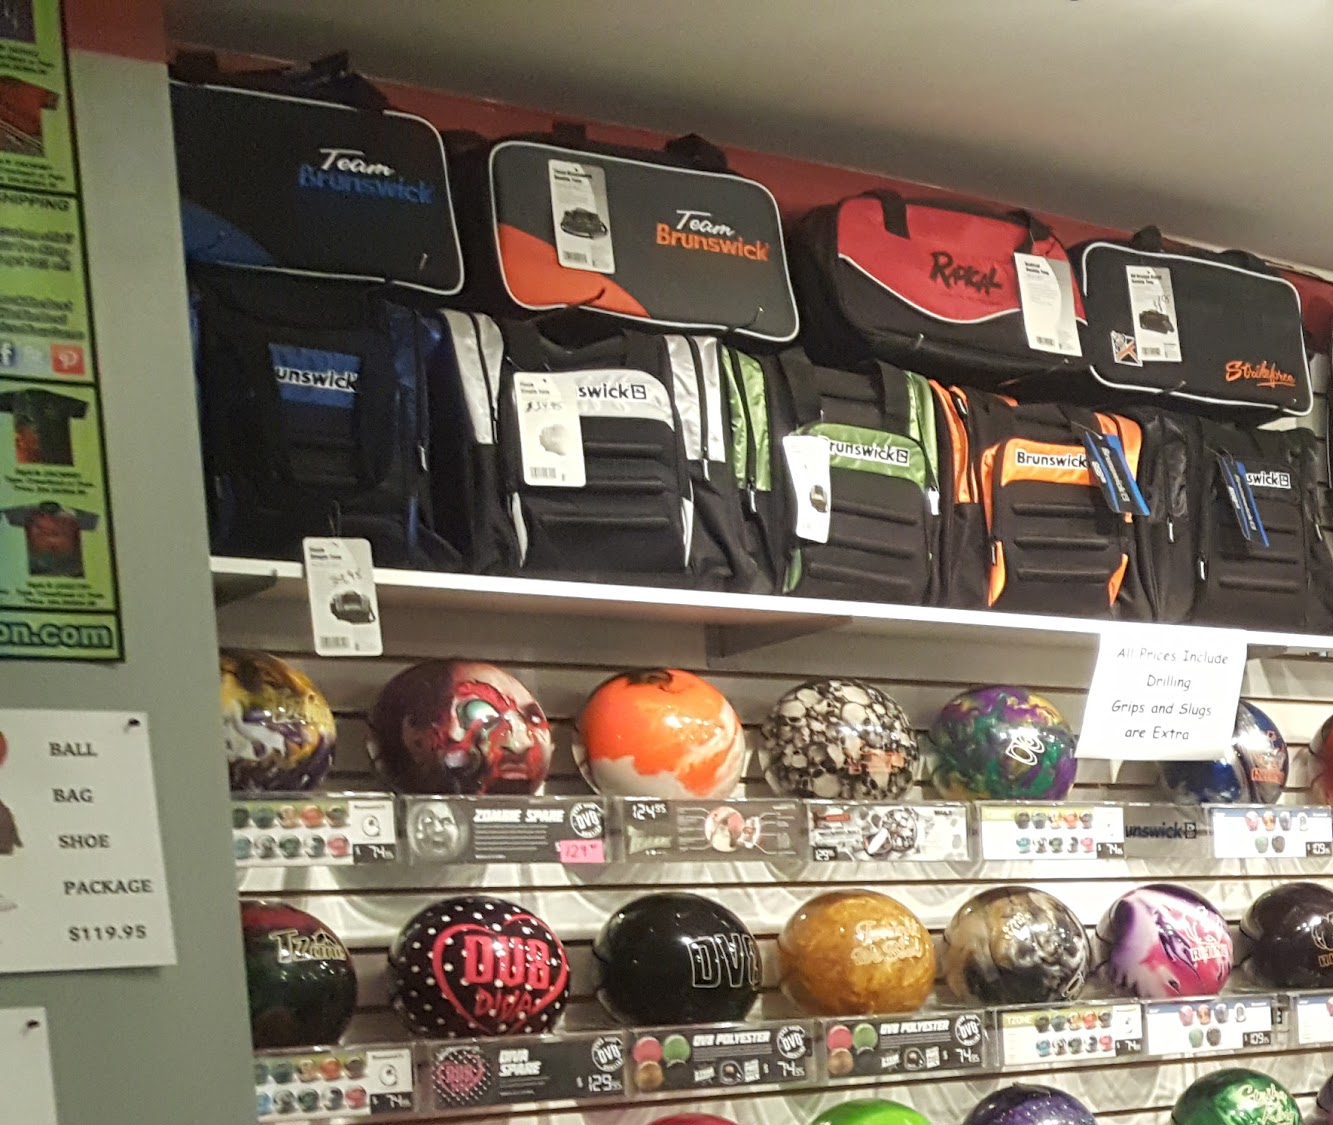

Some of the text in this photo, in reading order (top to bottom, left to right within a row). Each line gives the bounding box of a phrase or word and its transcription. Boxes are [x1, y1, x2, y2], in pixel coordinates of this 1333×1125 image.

[319, 147, 394, 175] Team
[300, 167, 434, 204] Brunswick
[676, 209, 735, 238] Team
[655, 223, 770, 262] Brunswick
[273, 365, 358, 391] unswick
[578, 384, 630, 399] swick
[1017, 450, 1088, 469] Brunswick
[1245, 470, 1280, 488] swick
[0, 622, 113, 648] on.com
[1117, 647, 1230, 667] All Prices Include
[1146, 674, 1192, 693] Drilling
[1111, 700, 1213, 719] Grips and Slugs
[1125, 726, 1191, 742] are Extra
[49, 741, 99, 758] BALL
[52, 787, 95, 805] BAG
[1125, 823, 1183, 839] unswick
[58, 833, 111, 850] SHOE
[63, 878, 154, 896] PACKAGE
[68, 924, 148, 943] $119.95
[900, 1020, 950, 1033] POLYESTER
[715, 1031, 771, 1046] POLYESTER
